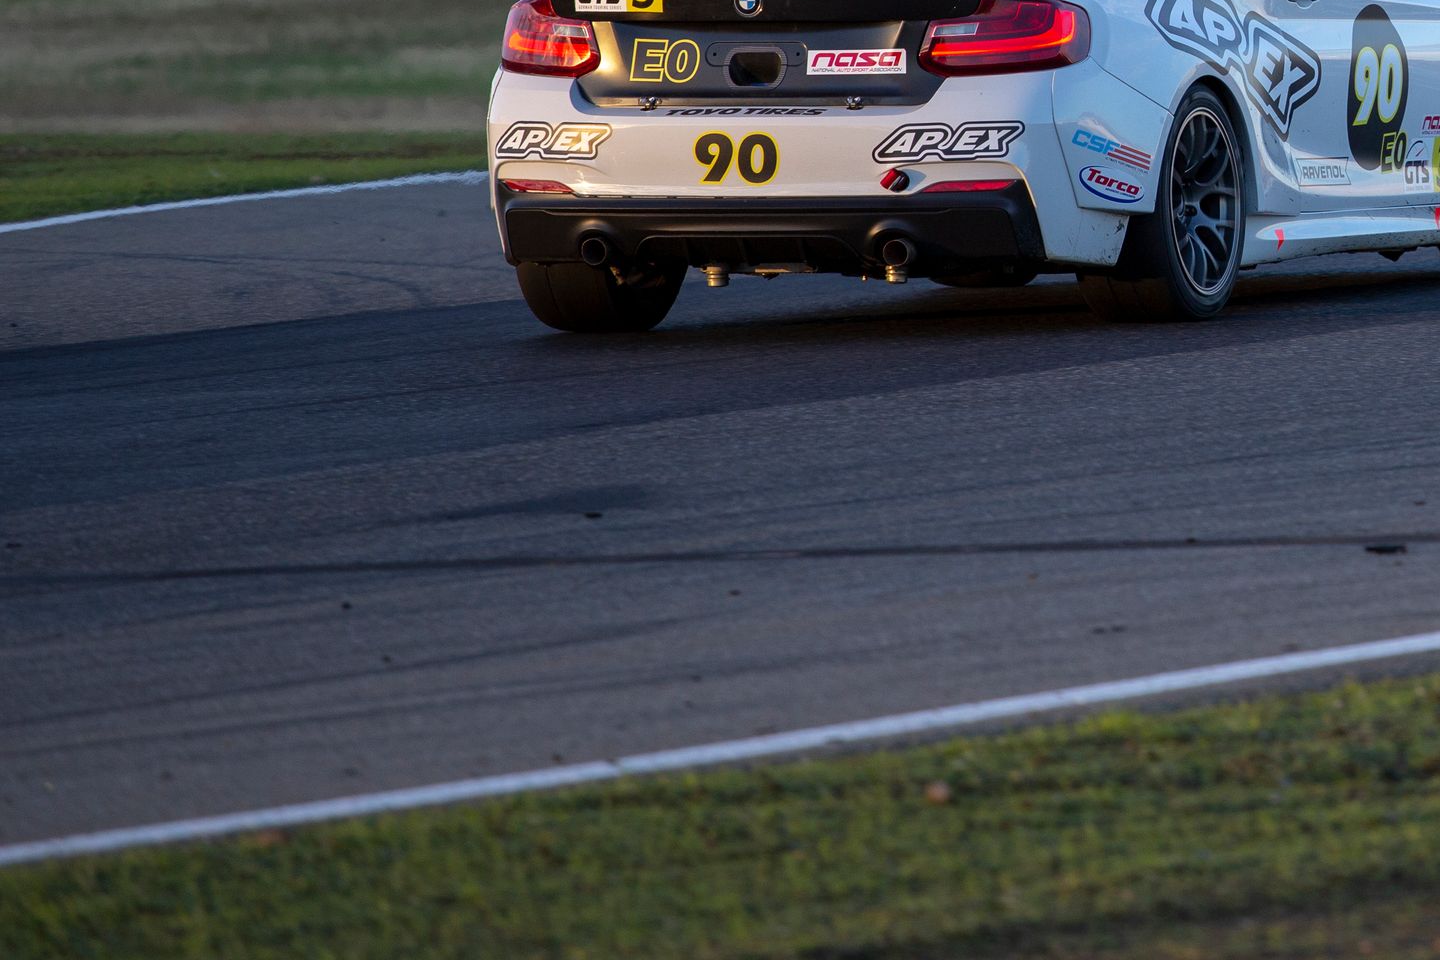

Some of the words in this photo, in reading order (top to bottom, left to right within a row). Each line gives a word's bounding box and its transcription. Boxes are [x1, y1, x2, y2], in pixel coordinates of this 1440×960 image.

[1352, 44, 1403, 126] 90
[666, 108, 741, 116] TOYO
[743, 108, 827, 116] TIRES
[498, 125, 606, 156] APEX
[879, 125, 1018, 159] APEX
[1072, 129, 1120, 154] CSF
[693, 130, 779, 186] 90
[1087, 168, 1140, 195] Torco
[1302, 165, 1345, 179] RAVENOL
[1405, 160, 1430, 184] GTS
